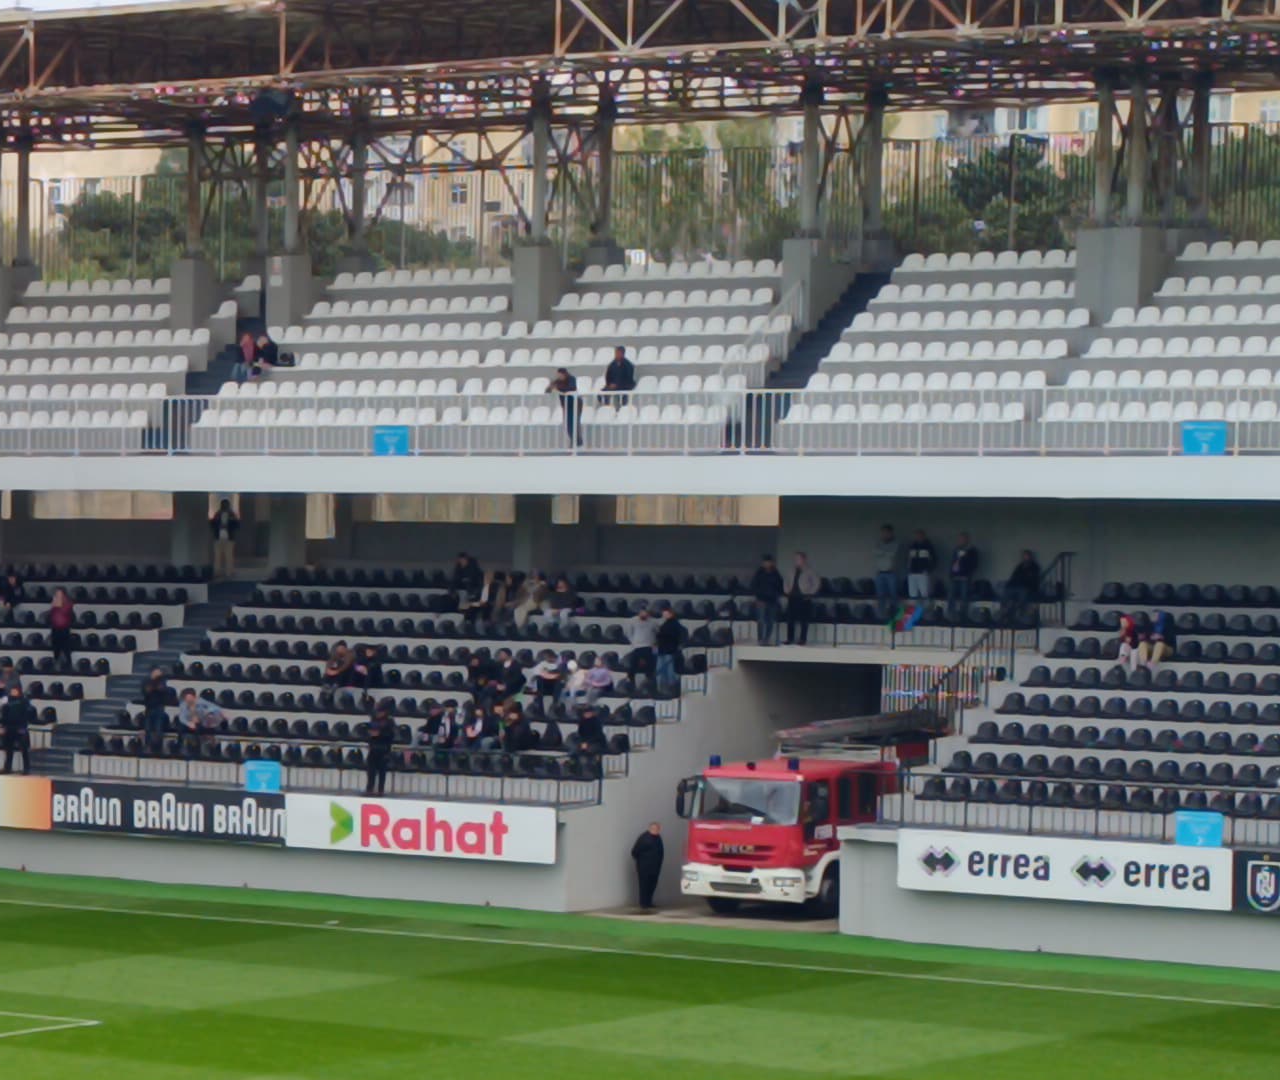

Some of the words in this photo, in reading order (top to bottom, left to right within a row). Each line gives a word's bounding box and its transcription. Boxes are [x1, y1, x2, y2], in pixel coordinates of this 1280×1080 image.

[53, 787, 122, 826] BRAUN
[134, 793, 205, 833] BRAUN
[361, 803, 509, 856] Rahat
[968, 850, 1051, 881] errea
[1123, 860, 1211, 892] errea
